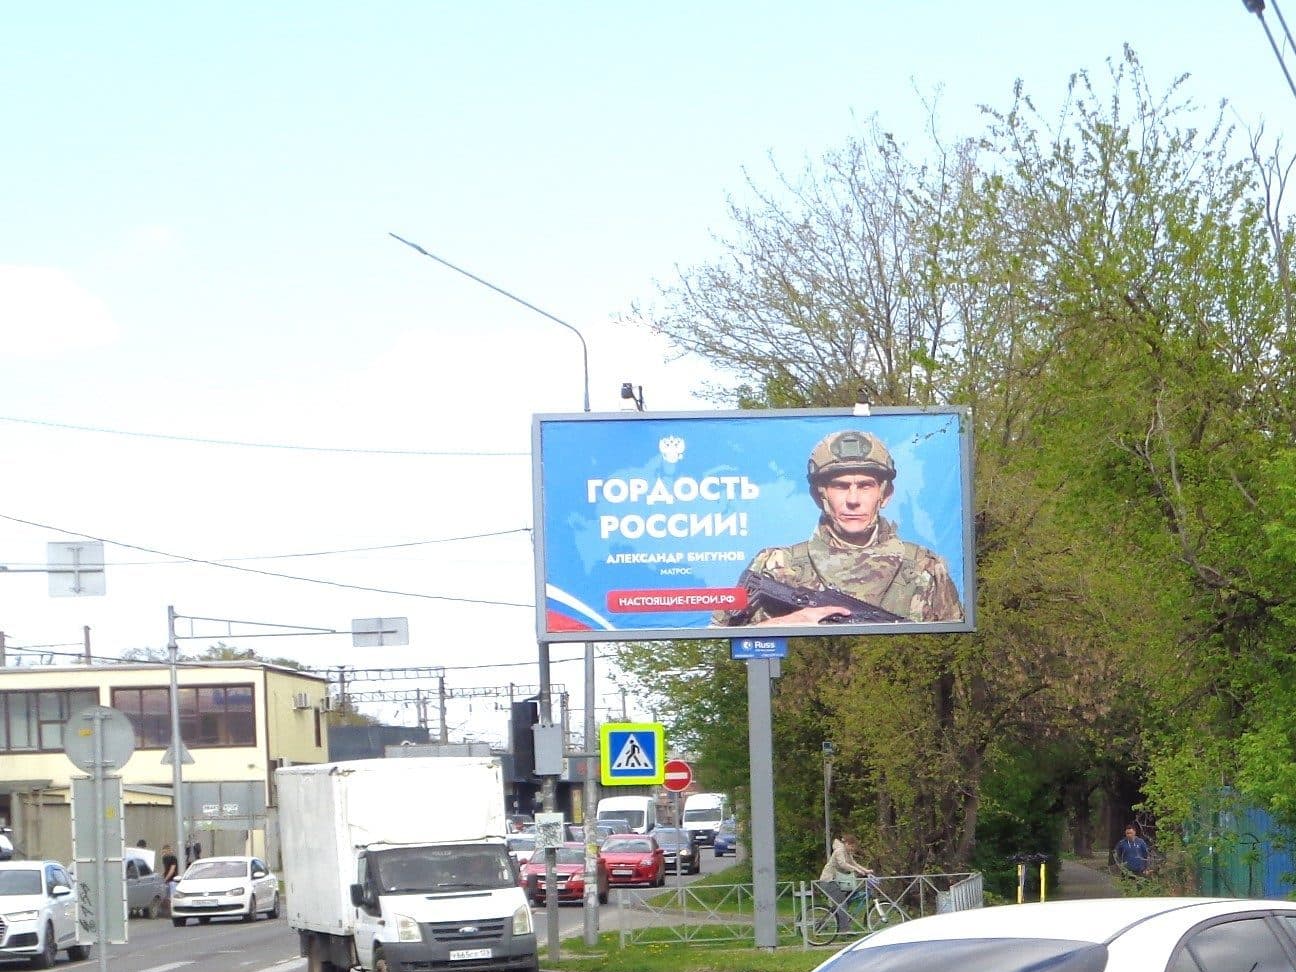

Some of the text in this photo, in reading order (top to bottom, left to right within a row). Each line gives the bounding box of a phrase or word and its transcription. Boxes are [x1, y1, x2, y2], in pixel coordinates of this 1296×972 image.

[587, 476, 760, 505] ГОРДОСТЬ
[600, 512, 748, 539] РОССИИ!
[606, 551, 745, 565] АЛЕКСАНДР БИГУНОВ
[660, 567, 692, 576] МАТРОС
[618, 594, 736, 608] НАСТОЯЩИЕ-ГЕРОИ.РФ
[754, 640, 776, 649] Russ
